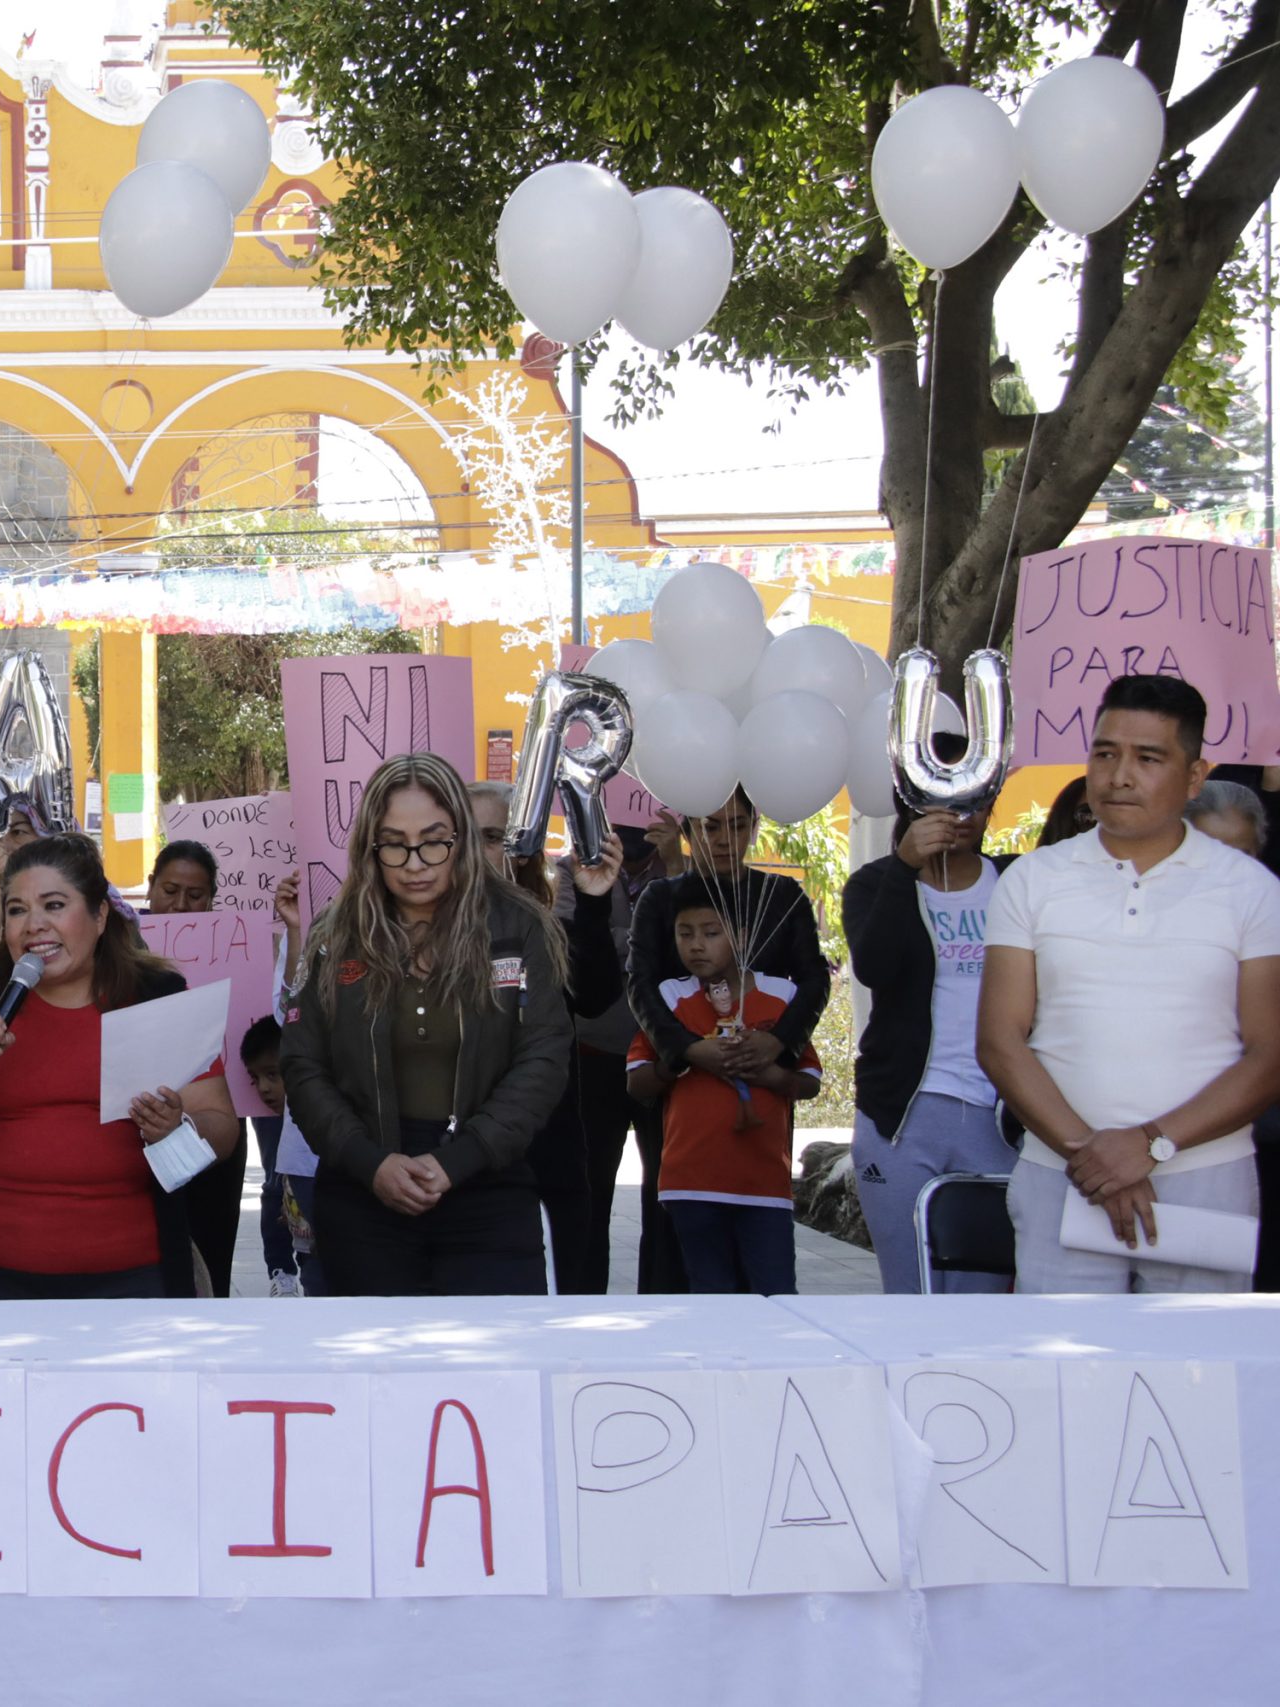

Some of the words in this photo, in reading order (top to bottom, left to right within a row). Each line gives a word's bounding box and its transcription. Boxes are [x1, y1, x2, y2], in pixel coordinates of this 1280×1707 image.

[321, 665, 431, 763] NI
[1050, 646, 1186, 688] PARA
[887, 648, 1014, 818] U
[1034, 702, 1249, 761] MU!
[571, 1371, 1231, 1590] PARA
